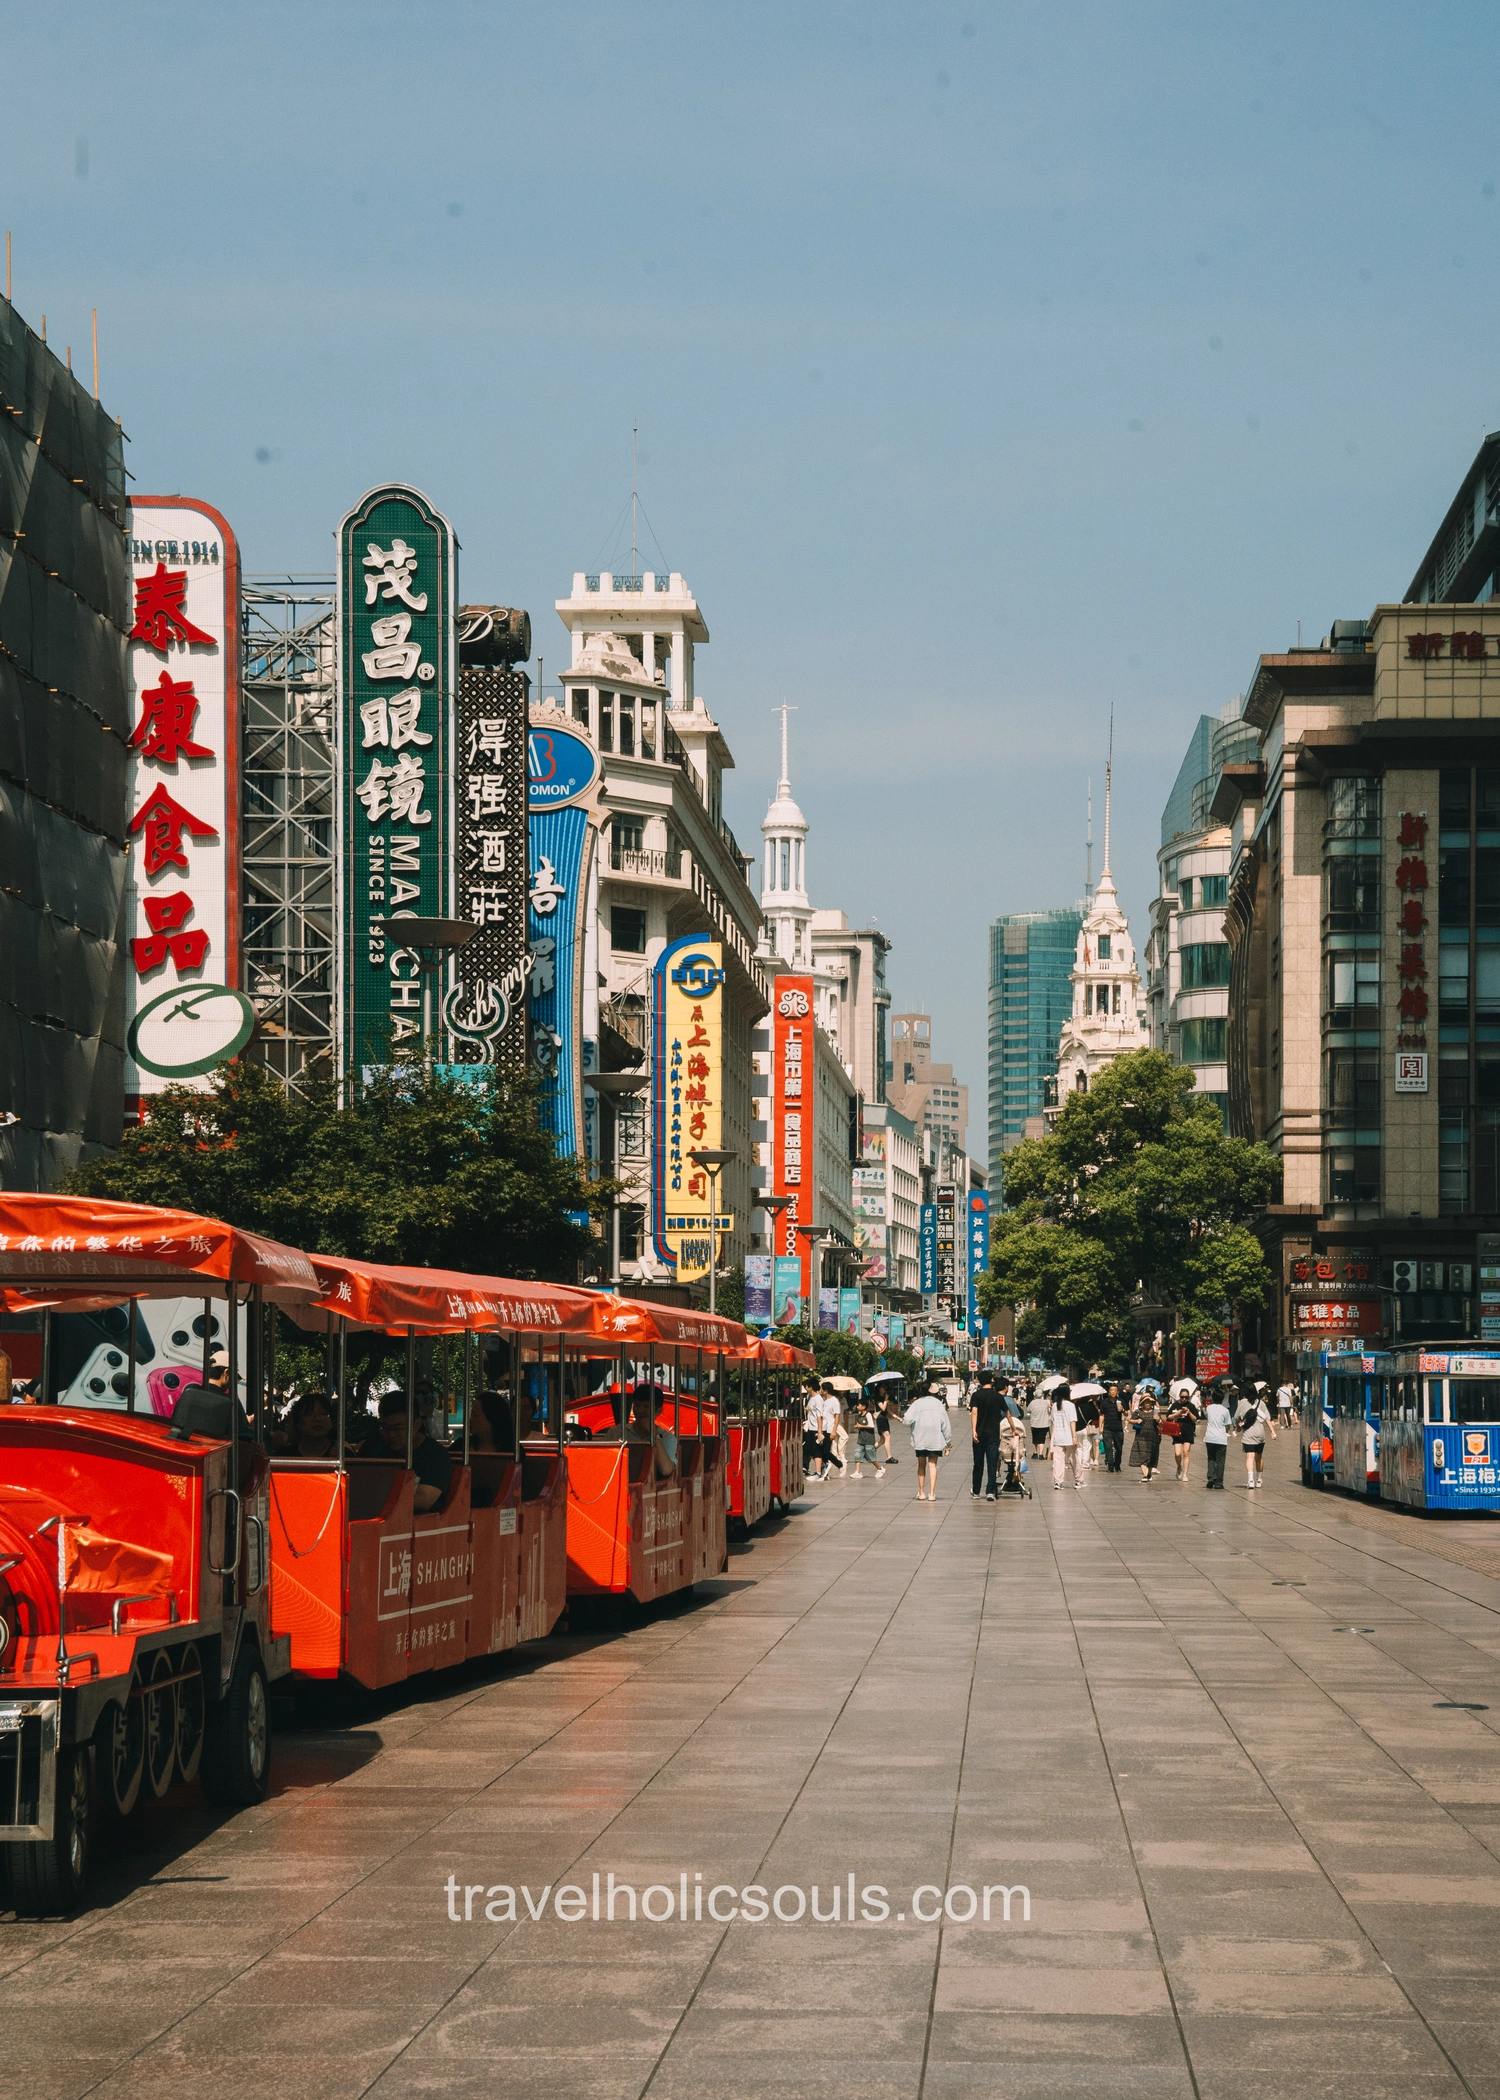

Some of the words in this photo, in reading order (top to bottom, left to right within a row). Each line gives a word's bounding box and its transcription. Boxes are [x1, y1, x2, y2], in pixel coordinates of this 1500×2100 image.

[131, 540, 179, 554] INCE
[182, 541, 218, 555] 1914
[1407, 631, 1500, 661] 新雅
[356, 538, 433, 824] 茂昌眼镜
[127, 562, 219, 973] 泰康食品
[369, 836, 385, 900] SINCE
[369, 913, 385, 964] 1923
[784, 1026, 803, 1184] 上海市第一食品商店
[786, 1193, 798, 1220] First
[1294, 1261, 1369, 1280] 汤包馆
[447, 1294, 467, 1320] 上海
[1299, 1304, 1360, 1319] 新雅食品
[1440, 1468, 1500, 1484] 上海梅
[384, 1550, 412, 1597] 上海
[416, 1553, 474, 1585] SHANGHAI
